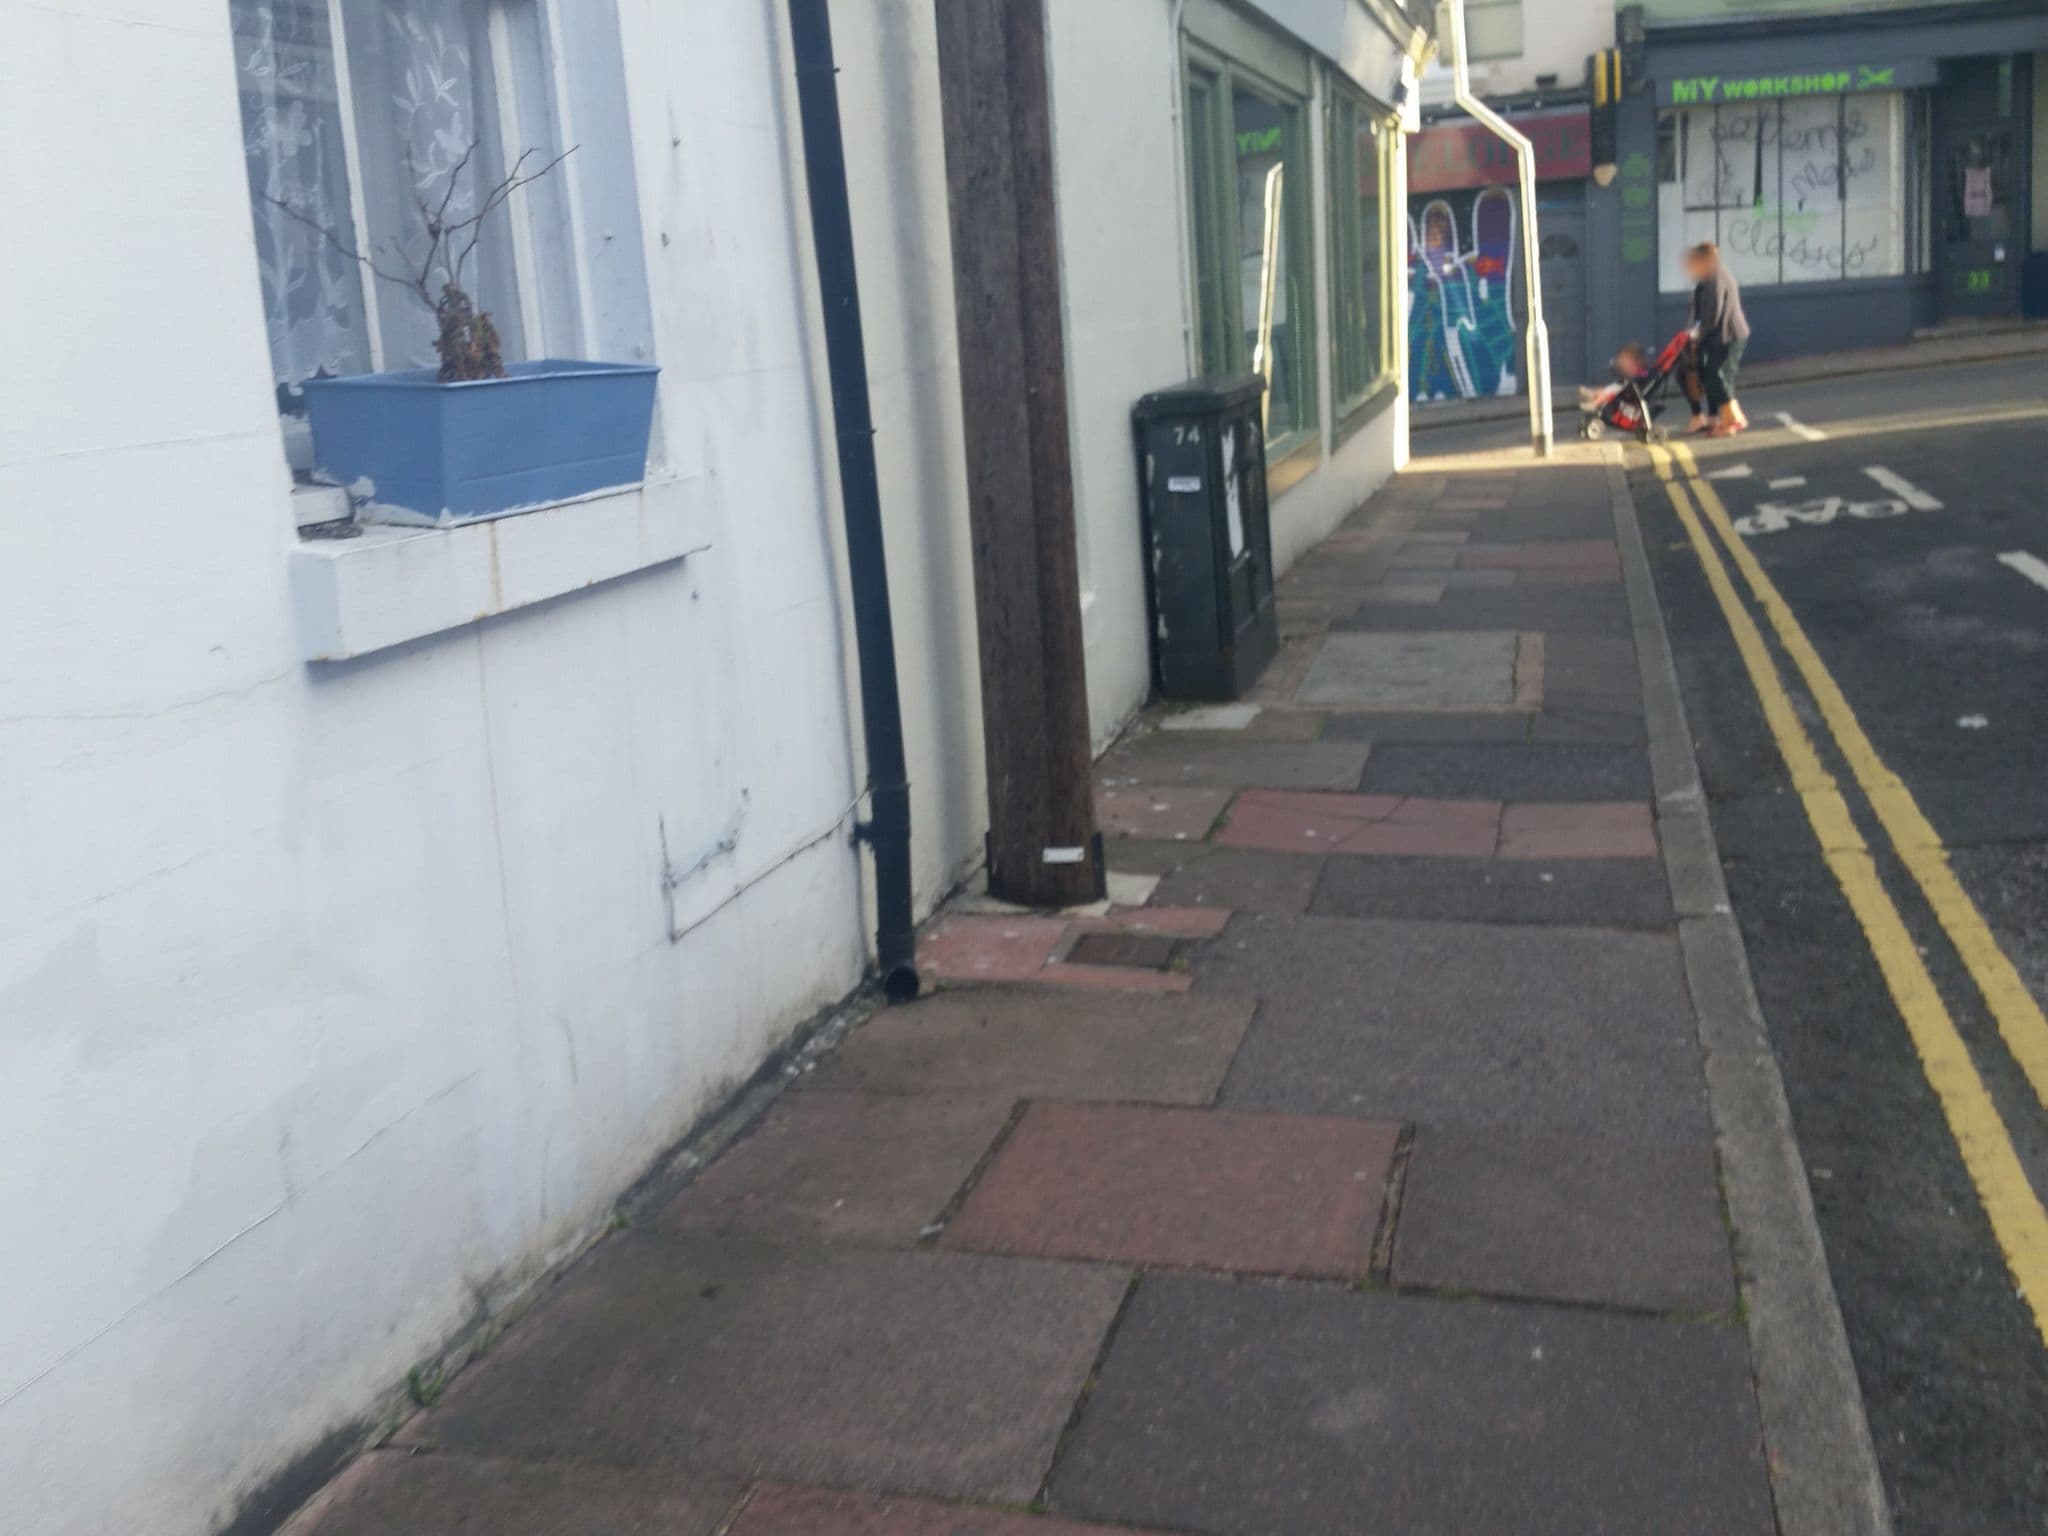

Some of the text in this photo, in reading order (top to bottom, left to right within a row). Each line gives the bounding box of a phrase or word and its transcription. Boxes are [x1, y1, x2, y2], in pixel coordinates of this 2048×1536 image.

[1672, 71, 1850, 103] MY WORKSHOP
[1173, 425, 1200, 446] 74
